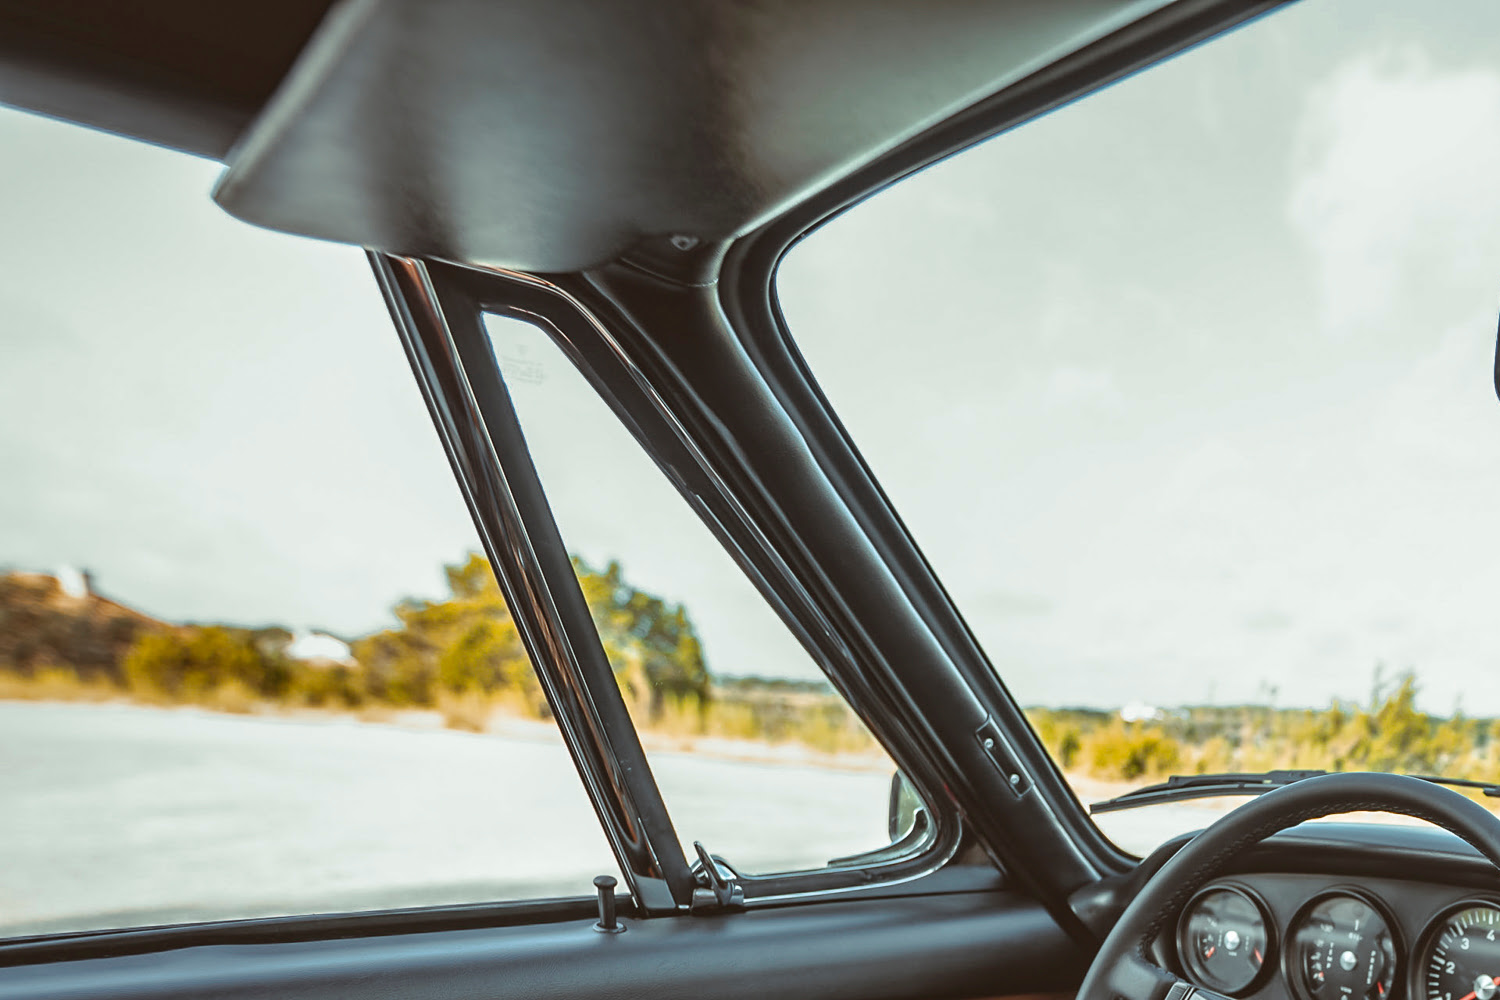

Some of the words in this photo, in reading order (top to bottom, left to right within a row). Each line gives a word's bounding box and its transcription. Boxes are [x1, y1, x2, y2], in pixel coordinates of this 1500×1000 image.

[1487, 929, 1495, 941] 4
[1461, 938, 1469, 950] 3
[1446, 962, 1455, 974] 2
